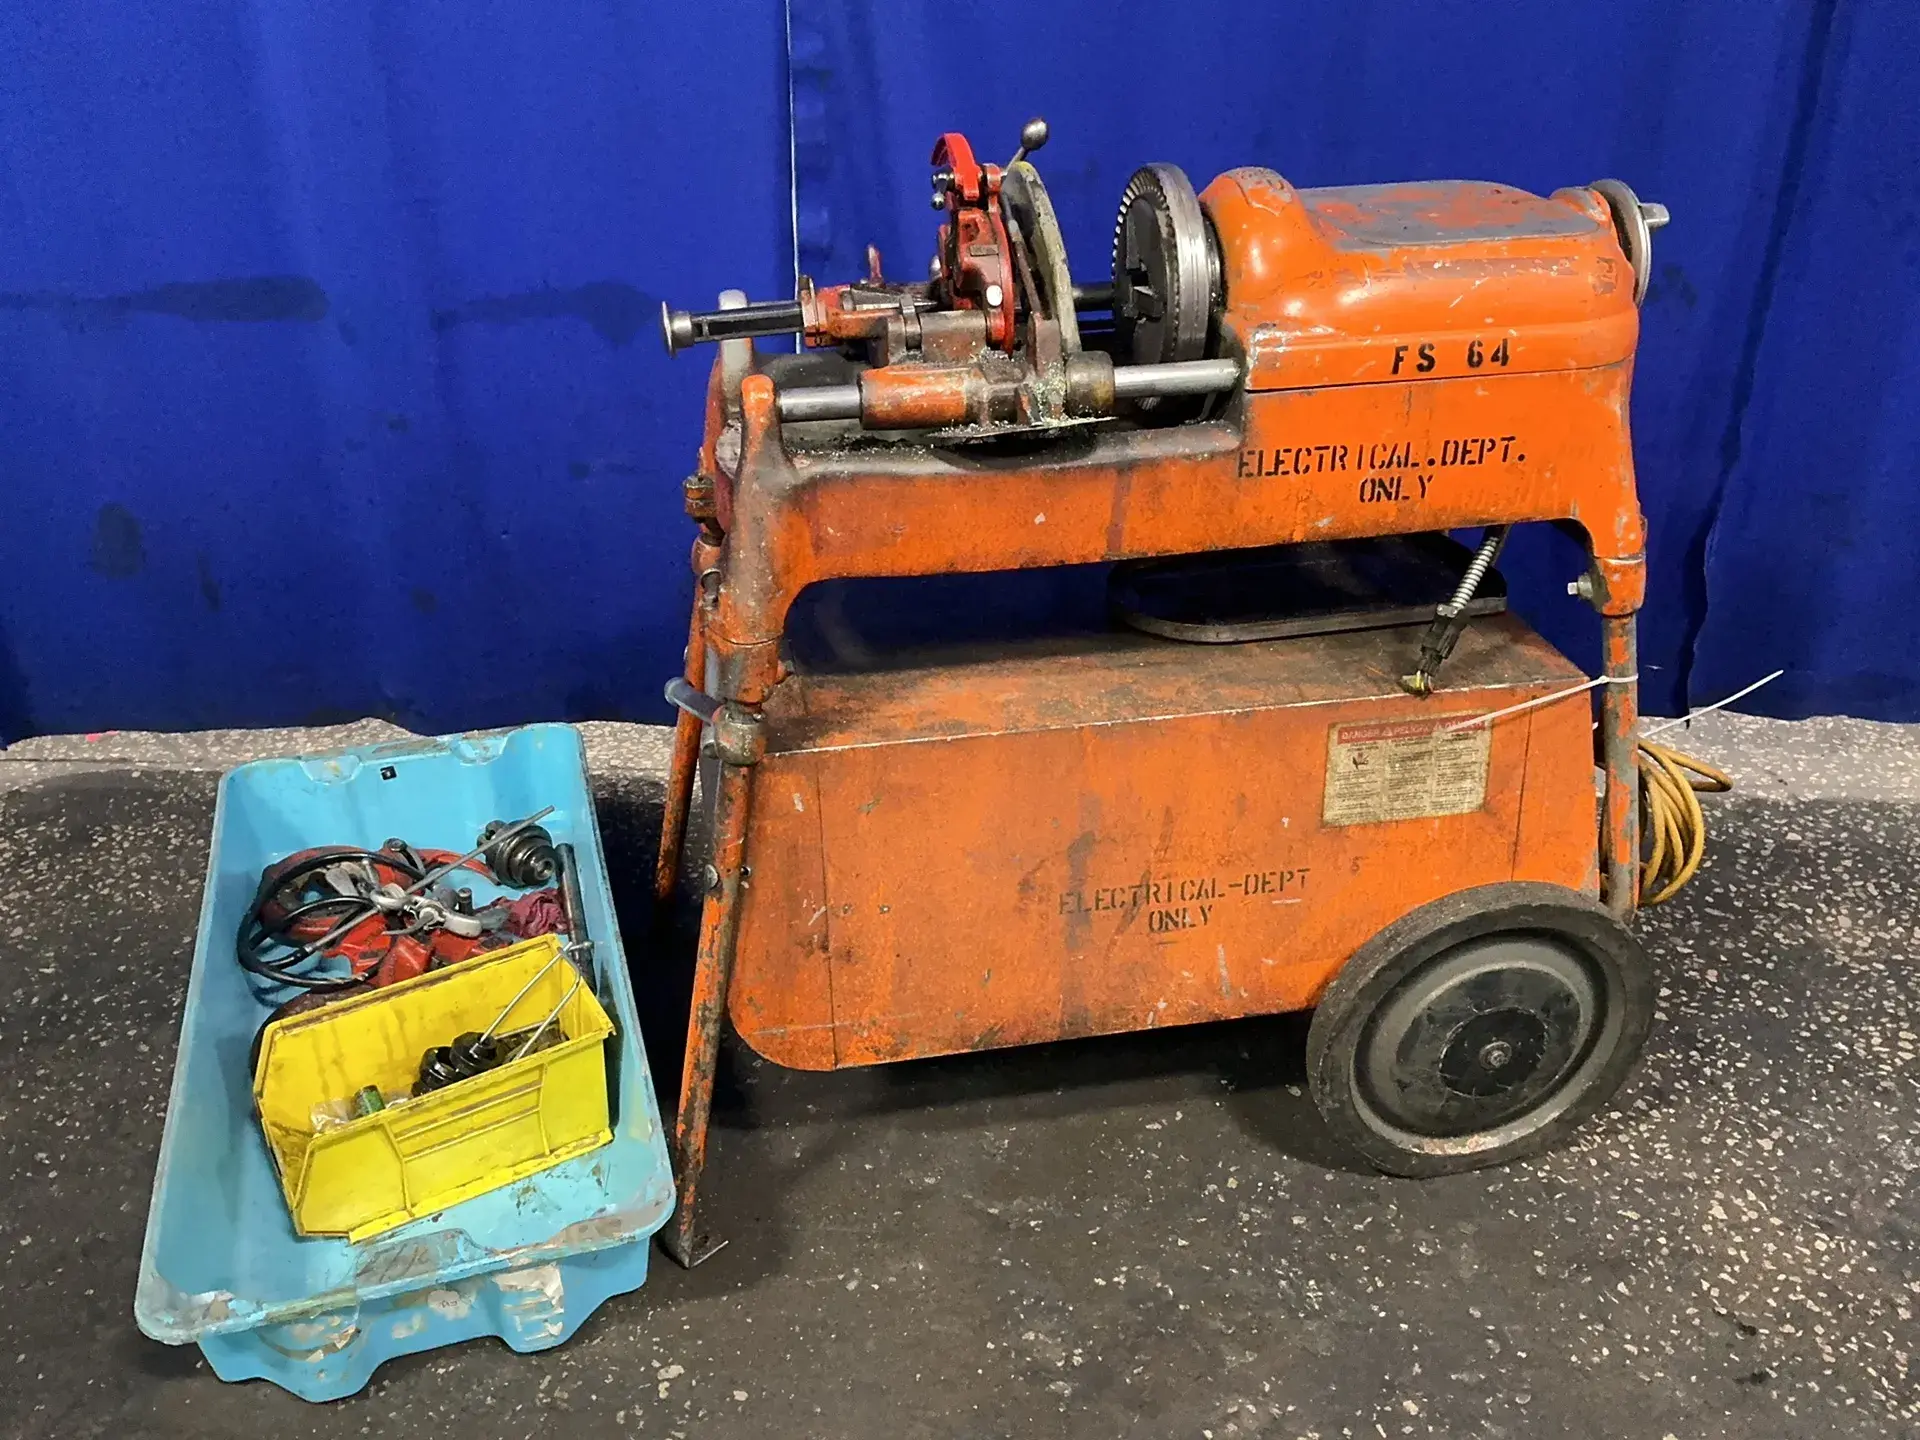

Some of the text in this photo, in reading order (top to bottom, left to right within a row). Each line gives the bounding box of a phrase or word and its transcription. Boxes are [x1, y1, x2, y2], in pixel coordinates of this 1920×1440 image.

[1391, 338, 1510, 375] FS 64
[1359, 474, 1434, 503] ONLY
[1148, 904, 1213, 933] ONLY
